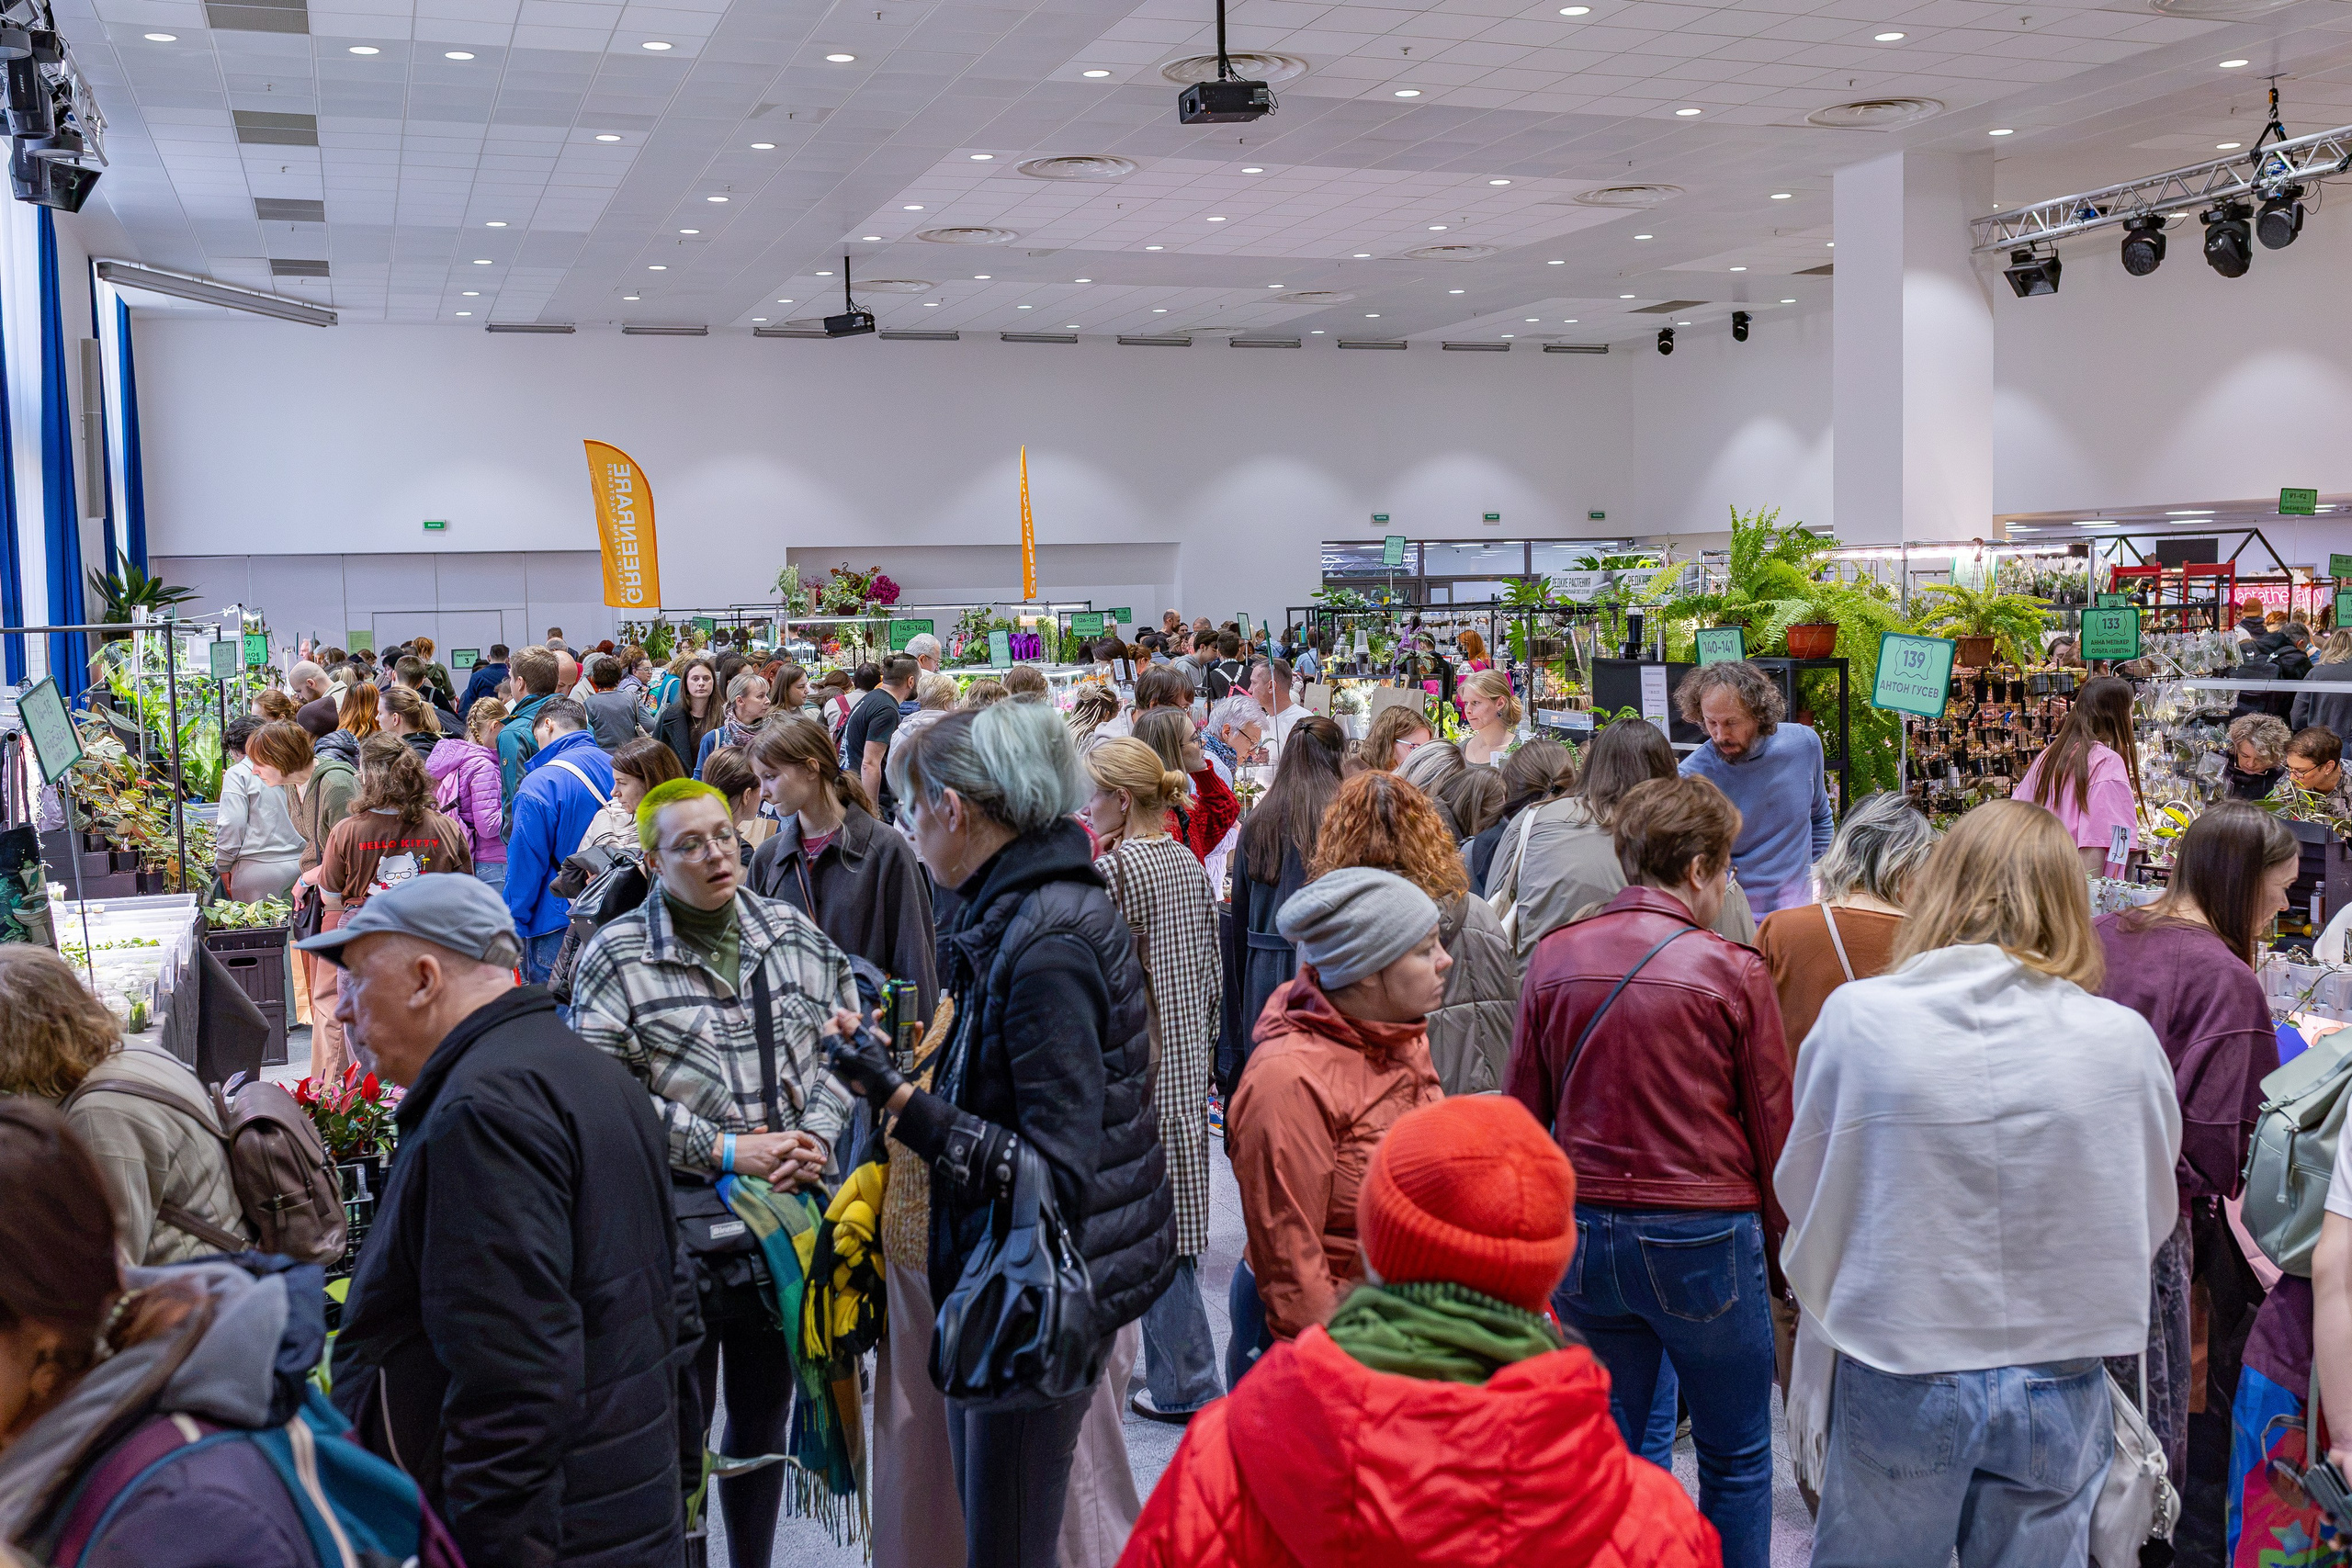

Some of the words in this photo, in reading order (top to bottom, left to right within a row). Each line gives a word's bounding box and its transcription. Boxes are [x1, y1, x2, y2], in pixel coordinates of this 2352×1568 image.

[1553, 577, 1568, 588] РЕДКИЕ
[1569, 577, 1590, 588] РАСТЕНИЯ
[2227, 586, 2324, 607] lantatheapy
[2102, 617, 2120, 629] 133
[1703, 640, 1734, 654] 140-141
[1903, 649, 1926, 669] 139
[1879, 680, 1910, 694] АНТОН
[1911, 684, 1939, 698] ГУСЕВ
[358, 840, 397, 851] HELLO
[401, 839, 439, 848] KITTY
